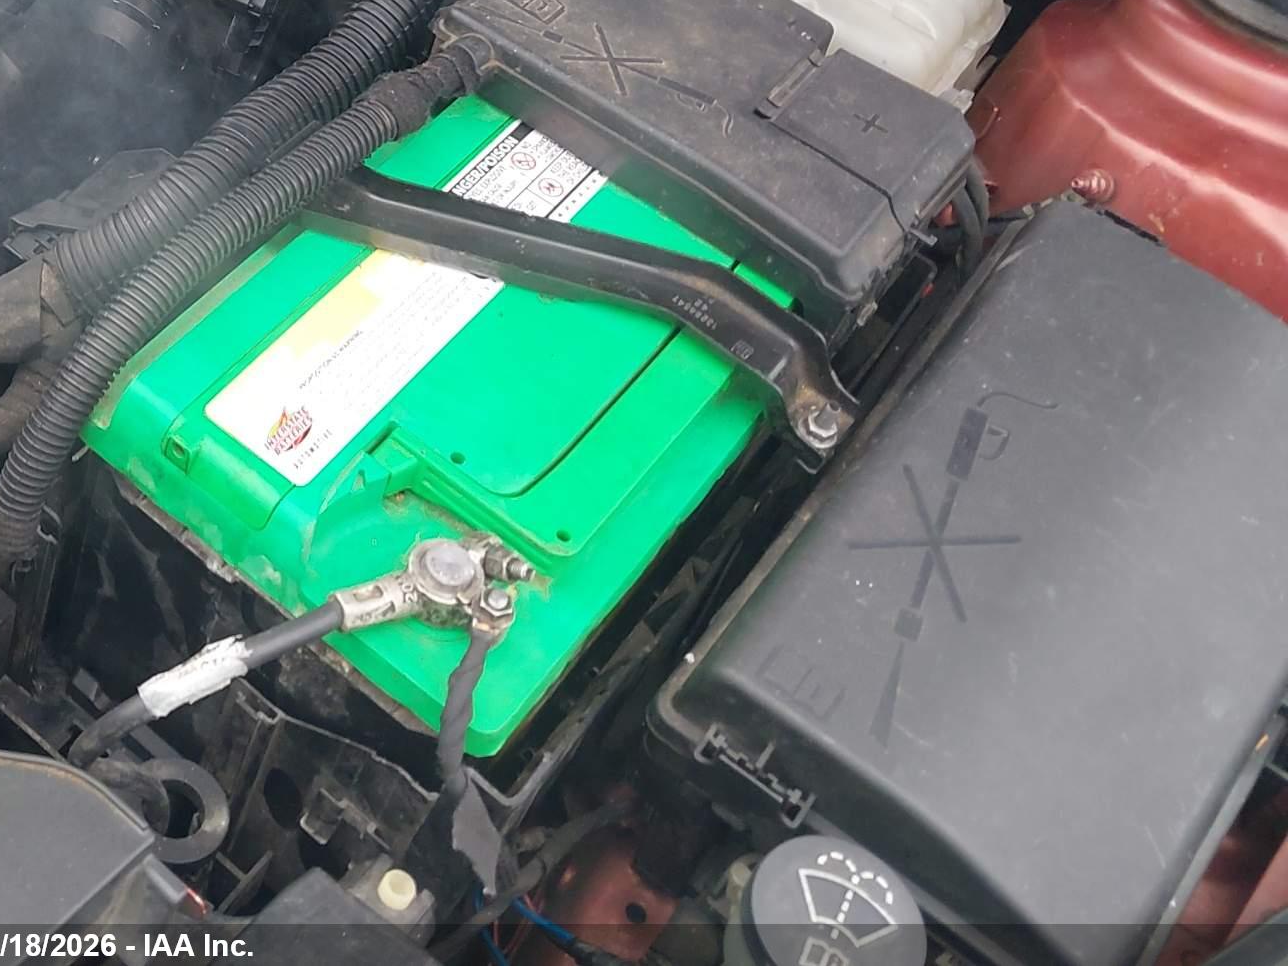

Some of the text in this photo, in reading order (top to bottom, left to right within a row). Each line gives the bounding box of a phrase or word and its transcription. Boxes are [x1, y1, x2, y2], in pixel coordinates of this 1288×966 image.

[451, 135, 519, 196] NGER/POISON
[263, 405, 310, 452] INTERSTATE
[274, 415, 314, 457] BATTERIES
